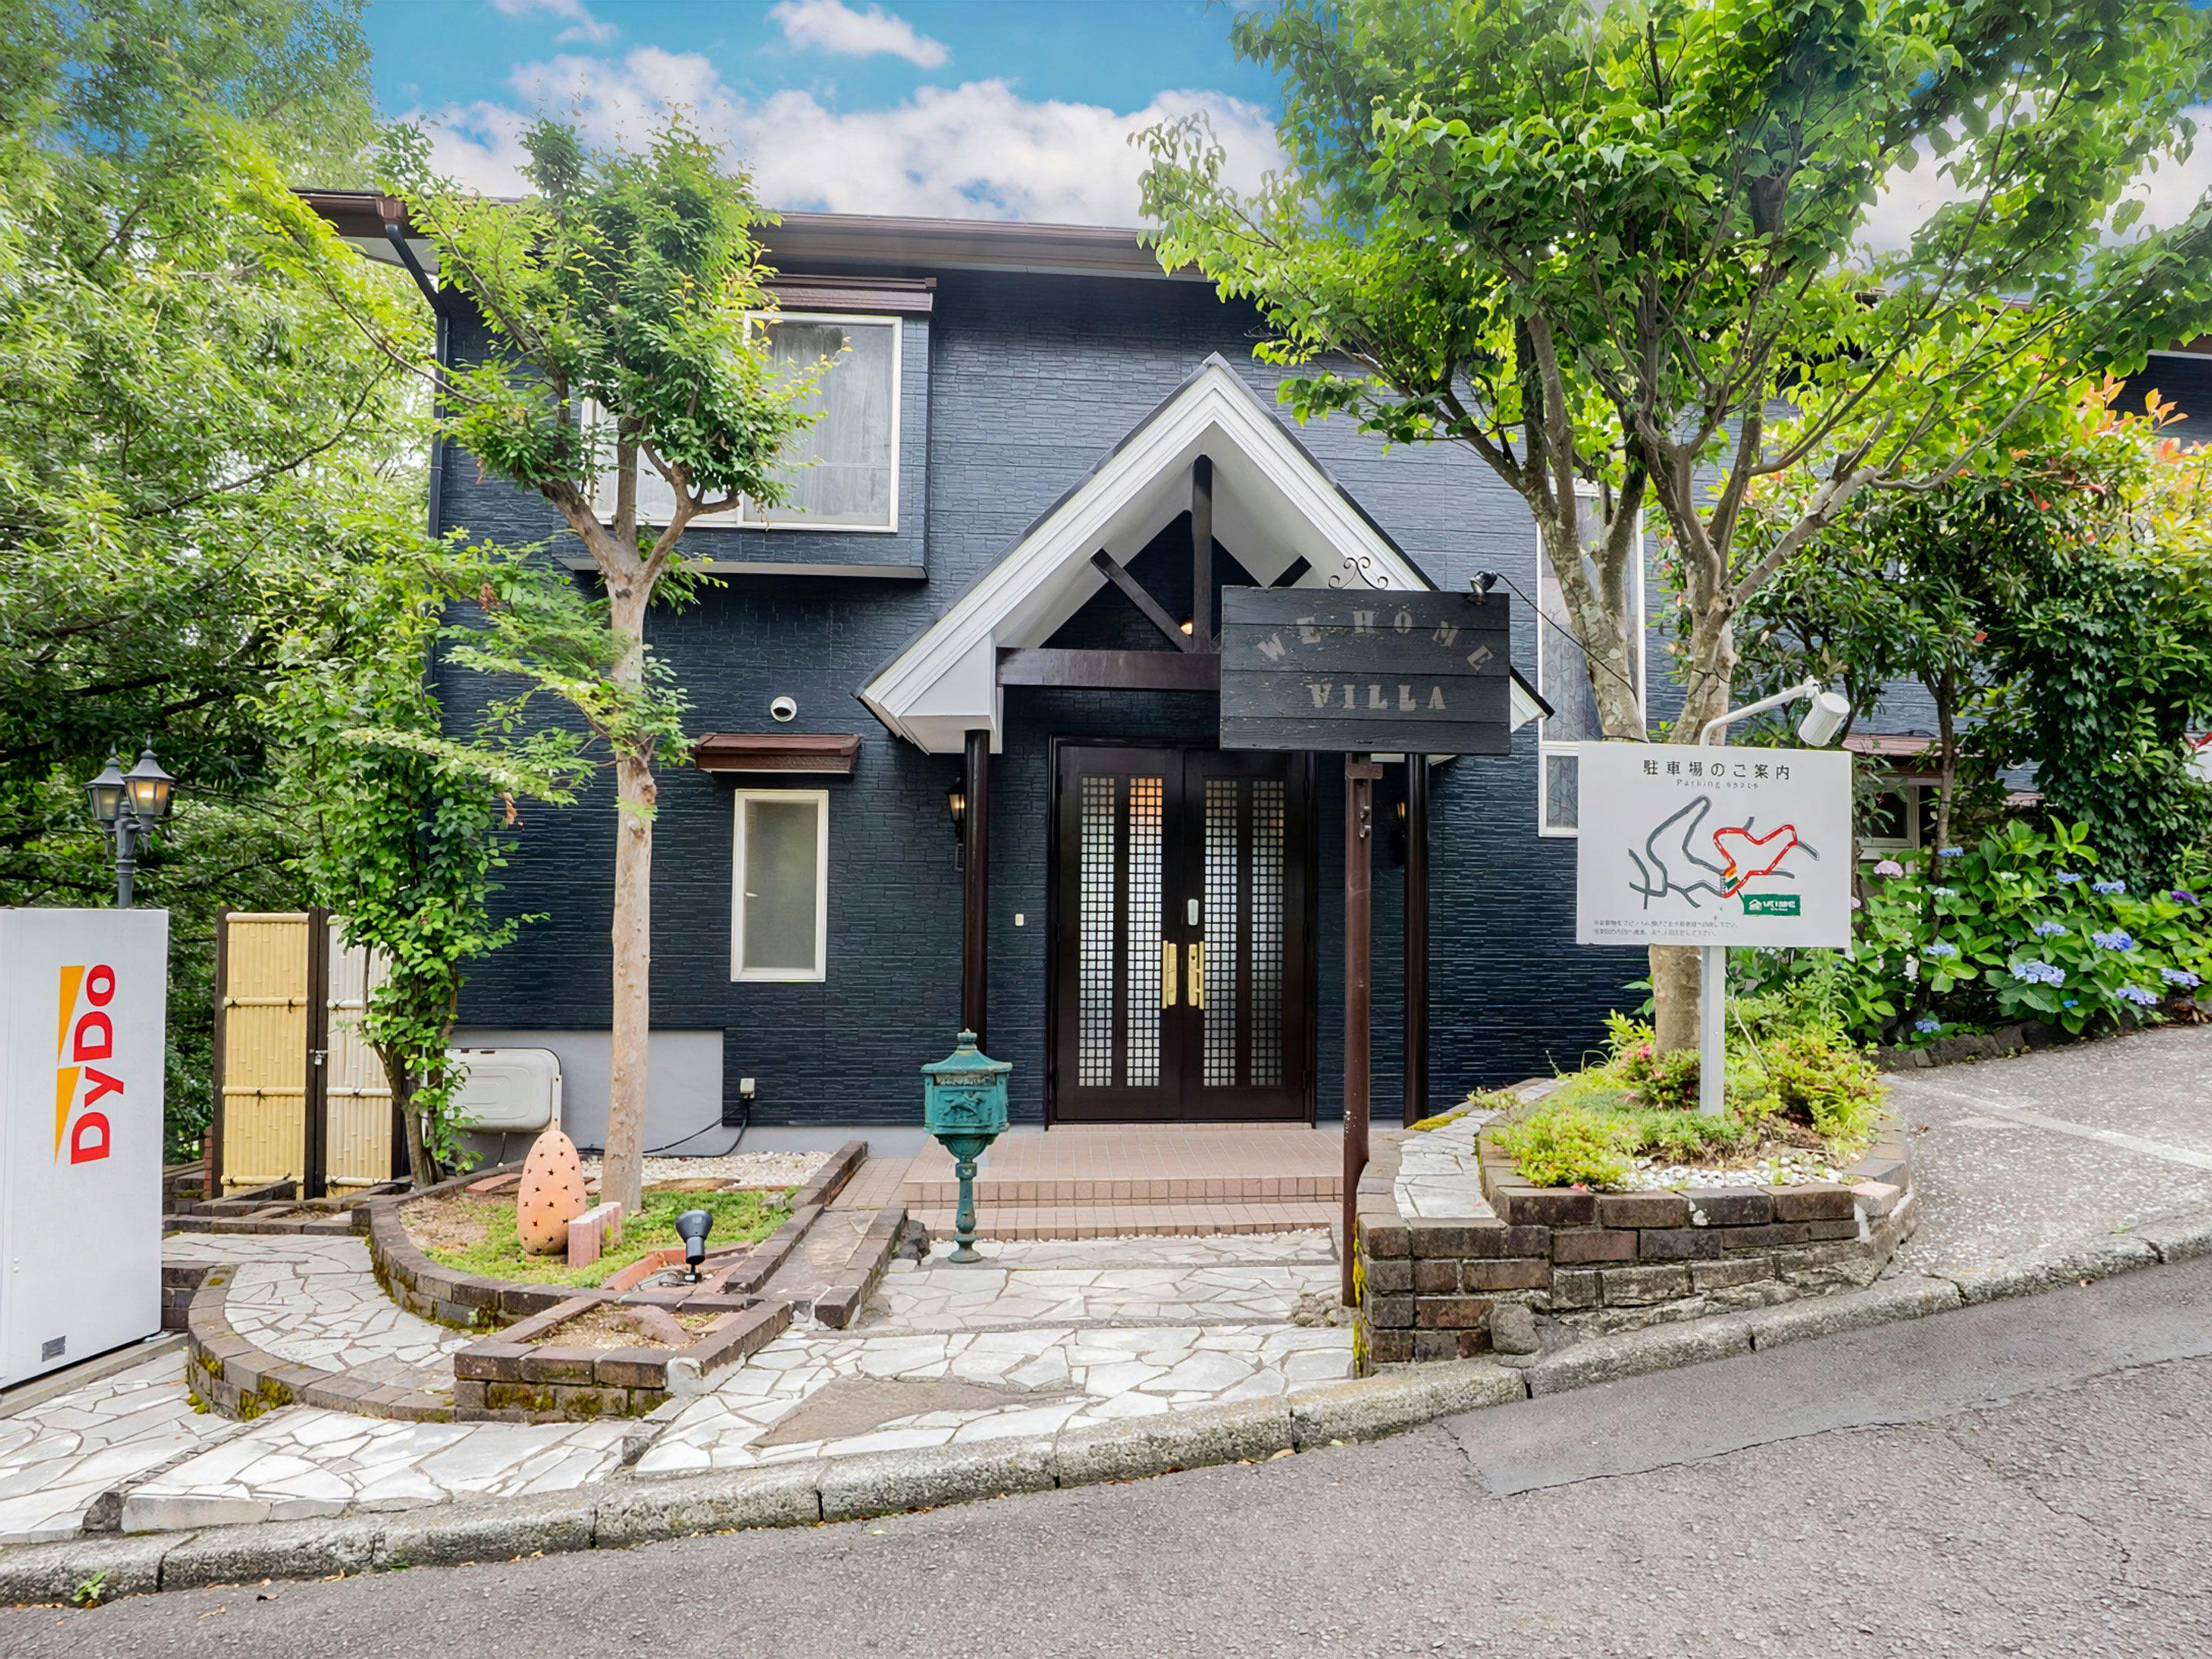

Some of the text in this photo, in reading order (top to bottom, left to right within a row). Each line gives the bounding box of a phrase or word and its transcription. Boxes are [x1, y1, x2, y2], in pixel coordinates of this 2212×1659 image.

[1306, 682, 1447, 712] VILLA
[1643, 759, 1790, 780] 駐車場のご案内
[71, 964, 124, 1165] DyDo
